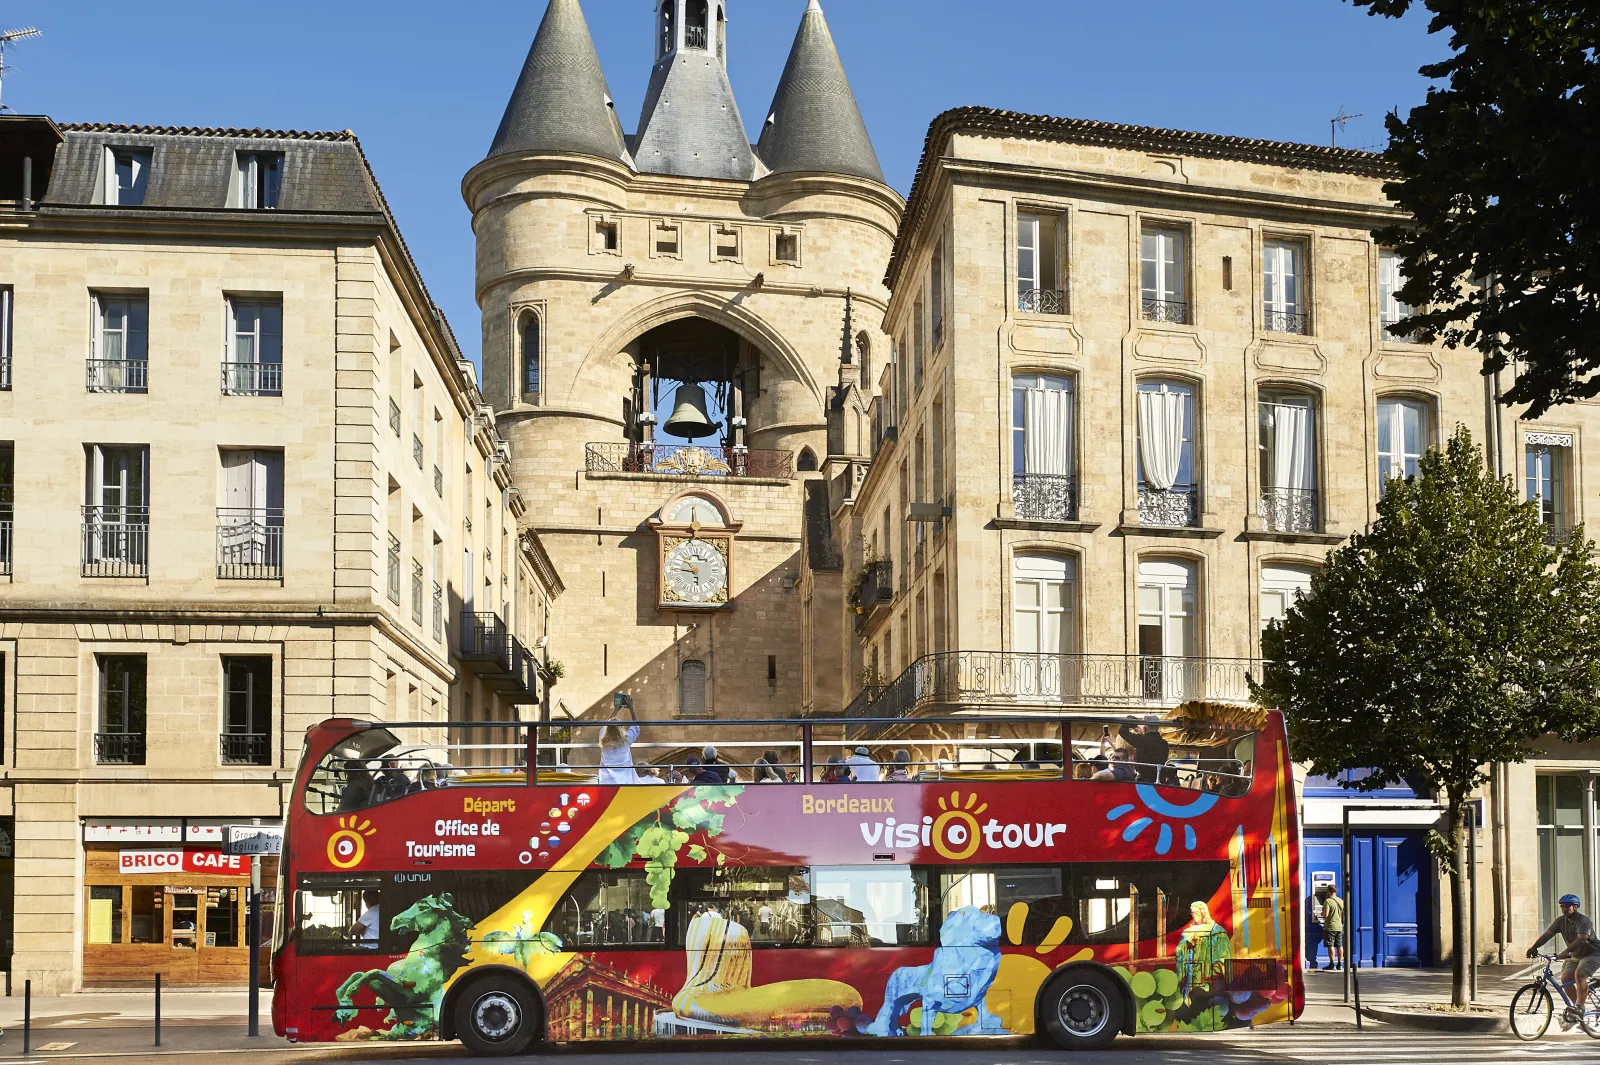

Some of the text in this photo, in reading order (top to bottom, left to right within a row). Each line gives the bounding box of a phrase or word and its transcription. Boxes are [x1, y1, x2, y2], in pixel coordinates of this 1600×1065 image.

[464, 797, 516, 816] Départ
[802, 795, 895, 814] Bordeaux
[234, 830, 261, 840] Grosse
[435, 819, 500, 836] Office de
[233, 840, 259, 853] Église
[406, 840, 476, 857] Tourisme
[121, 854, 180, 867] BRICO
[192, 852, 241, 869] CAFE
